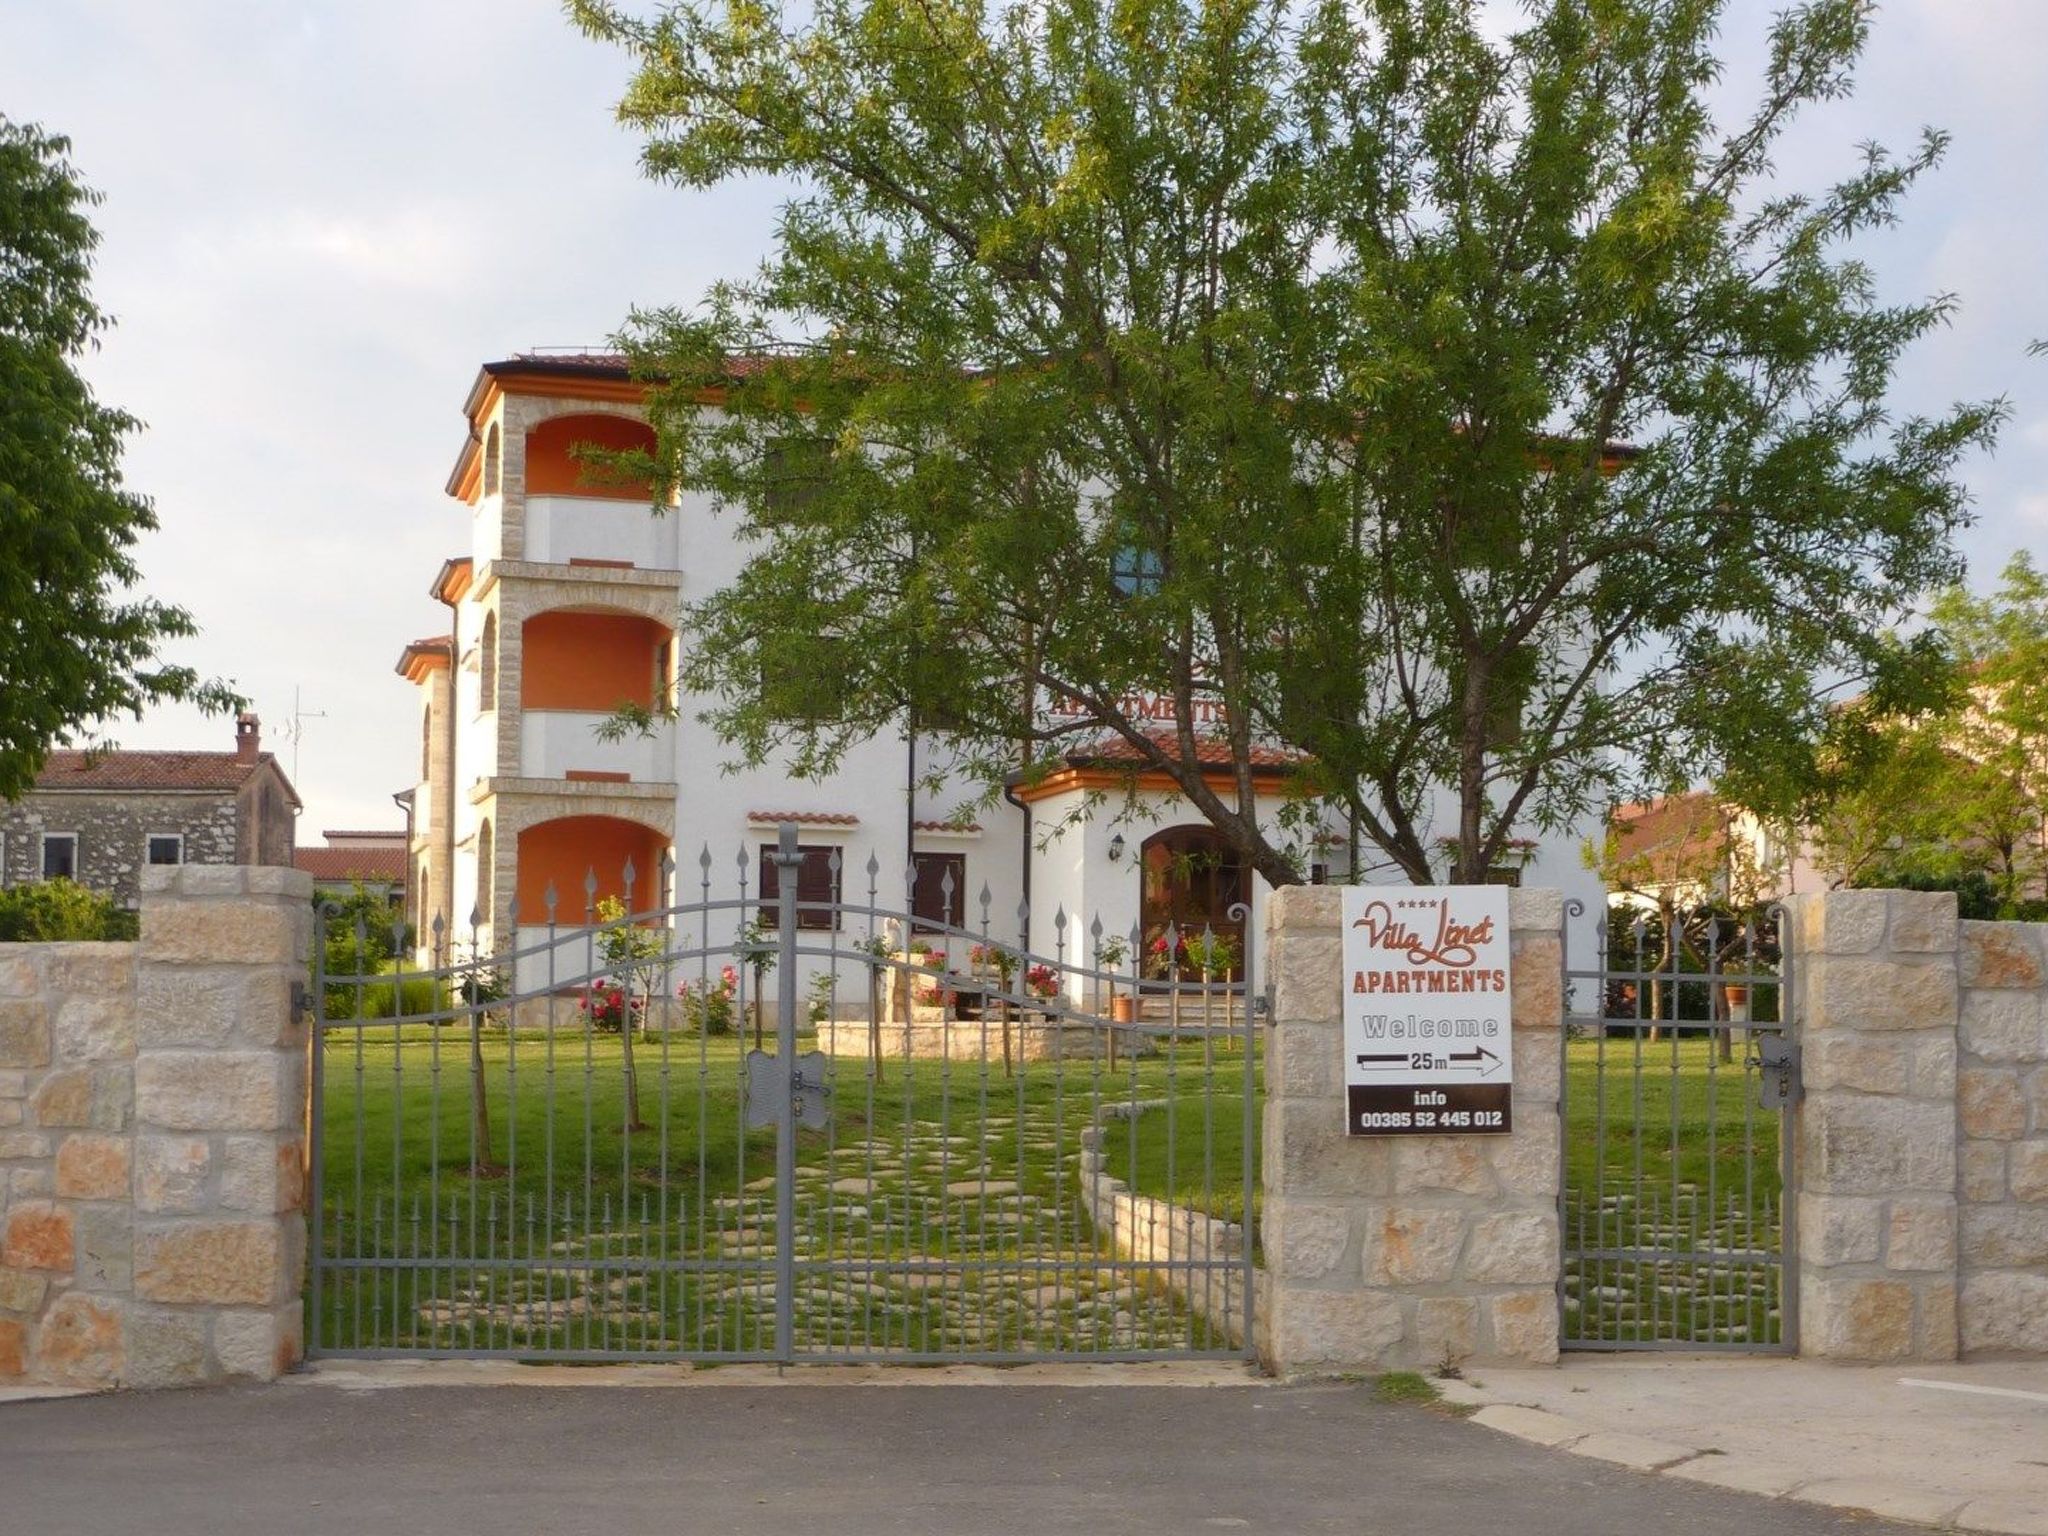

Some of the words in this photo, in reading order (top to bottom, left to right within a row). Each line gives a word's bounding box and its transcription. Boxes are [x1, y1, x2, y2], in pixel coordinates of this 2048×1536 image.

[1352, 900, 1423, 950] Villa
[1353, 969, 1506, 994] APARTMENTS
[1362, 1014, 1499, 1039] Welcome
[1413, 1090, 1447, 1106] info
[1361, 1112, 1412, 1128] 00385
[1415, 1112, 1436, 1127] 52
[1439, 1111, 1471, 1127] 445
[1474, 1111, 1503, 1126] 012
